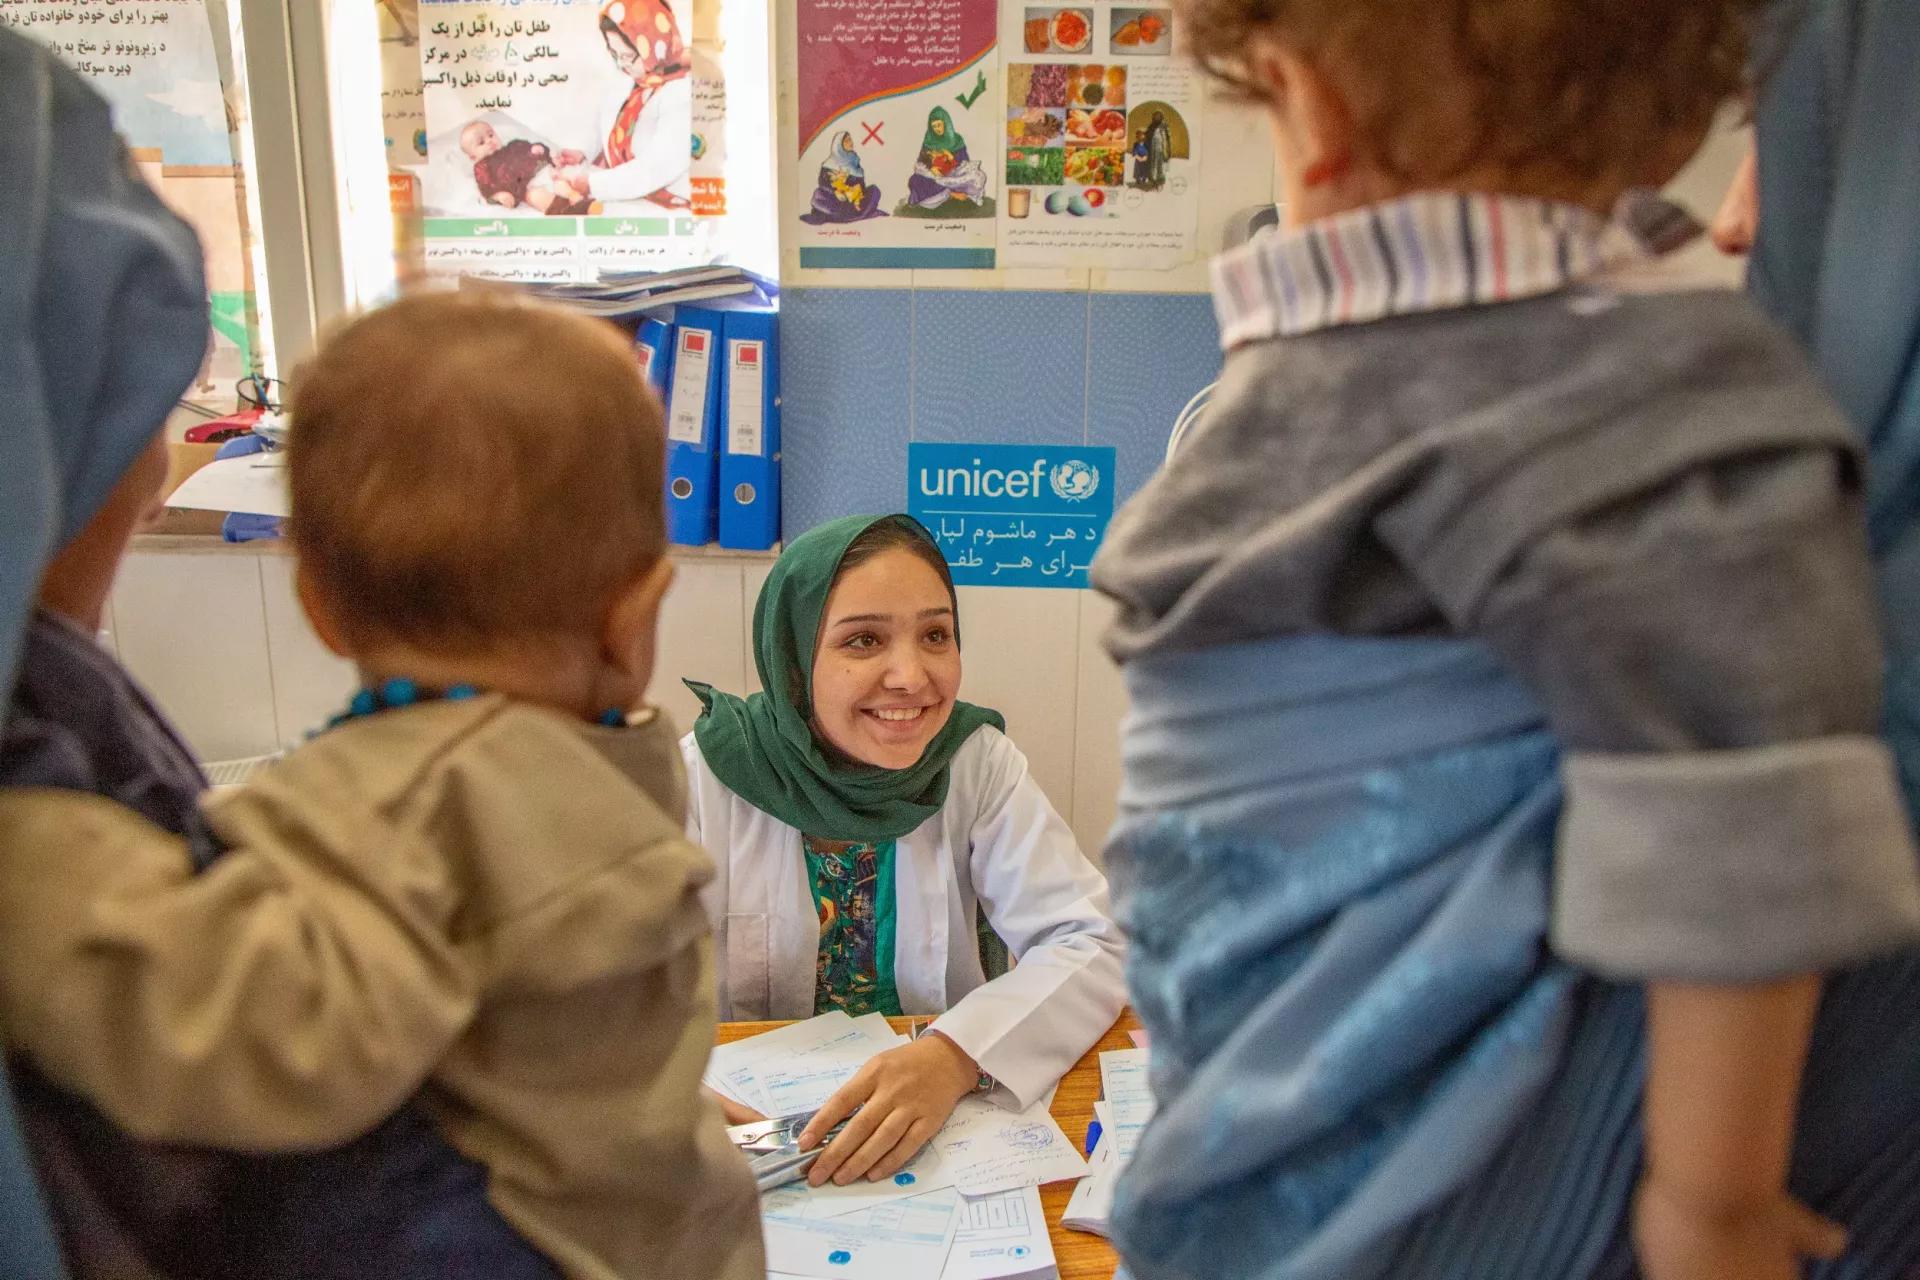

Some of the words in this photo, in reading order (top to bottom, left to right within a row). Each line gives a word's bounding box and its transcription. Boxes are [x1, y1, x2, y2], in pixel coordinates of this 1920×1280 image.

[109, 9, 135, 25] برای
[149, 9, 169, 25] بهتر
[431, 22, 450, 39] یک
[453, 21, 464, 38] از
[489, 20, 501, 38] را
[504, 20, 523, 37] تان
[525, 20, 551, 37] طفل
[101, 40, 111, 55] تر
[159, 42, 167, 52] د
[424, 47, 450, 64] مرکز
[523, 46, 560, 62] سالگی
[454, 49, 467, 64] در
[460, 71, 481, 88] ذیل
[521, 73, 535, 88] در
[537, 73, 569, 88] صحی
[920, 458, 1047, 498] unicef
[924, 517, 965, 544] لپار
[973, 519, 1037, 545] ماشوم
[1045, 527, 1077, 547] هر
[1084, 527, 1097, 541] د
[947, 547, 984, 567] طف
[990, 555, 1033, 575] هر
[1040, 550, 1091, 578] رای
